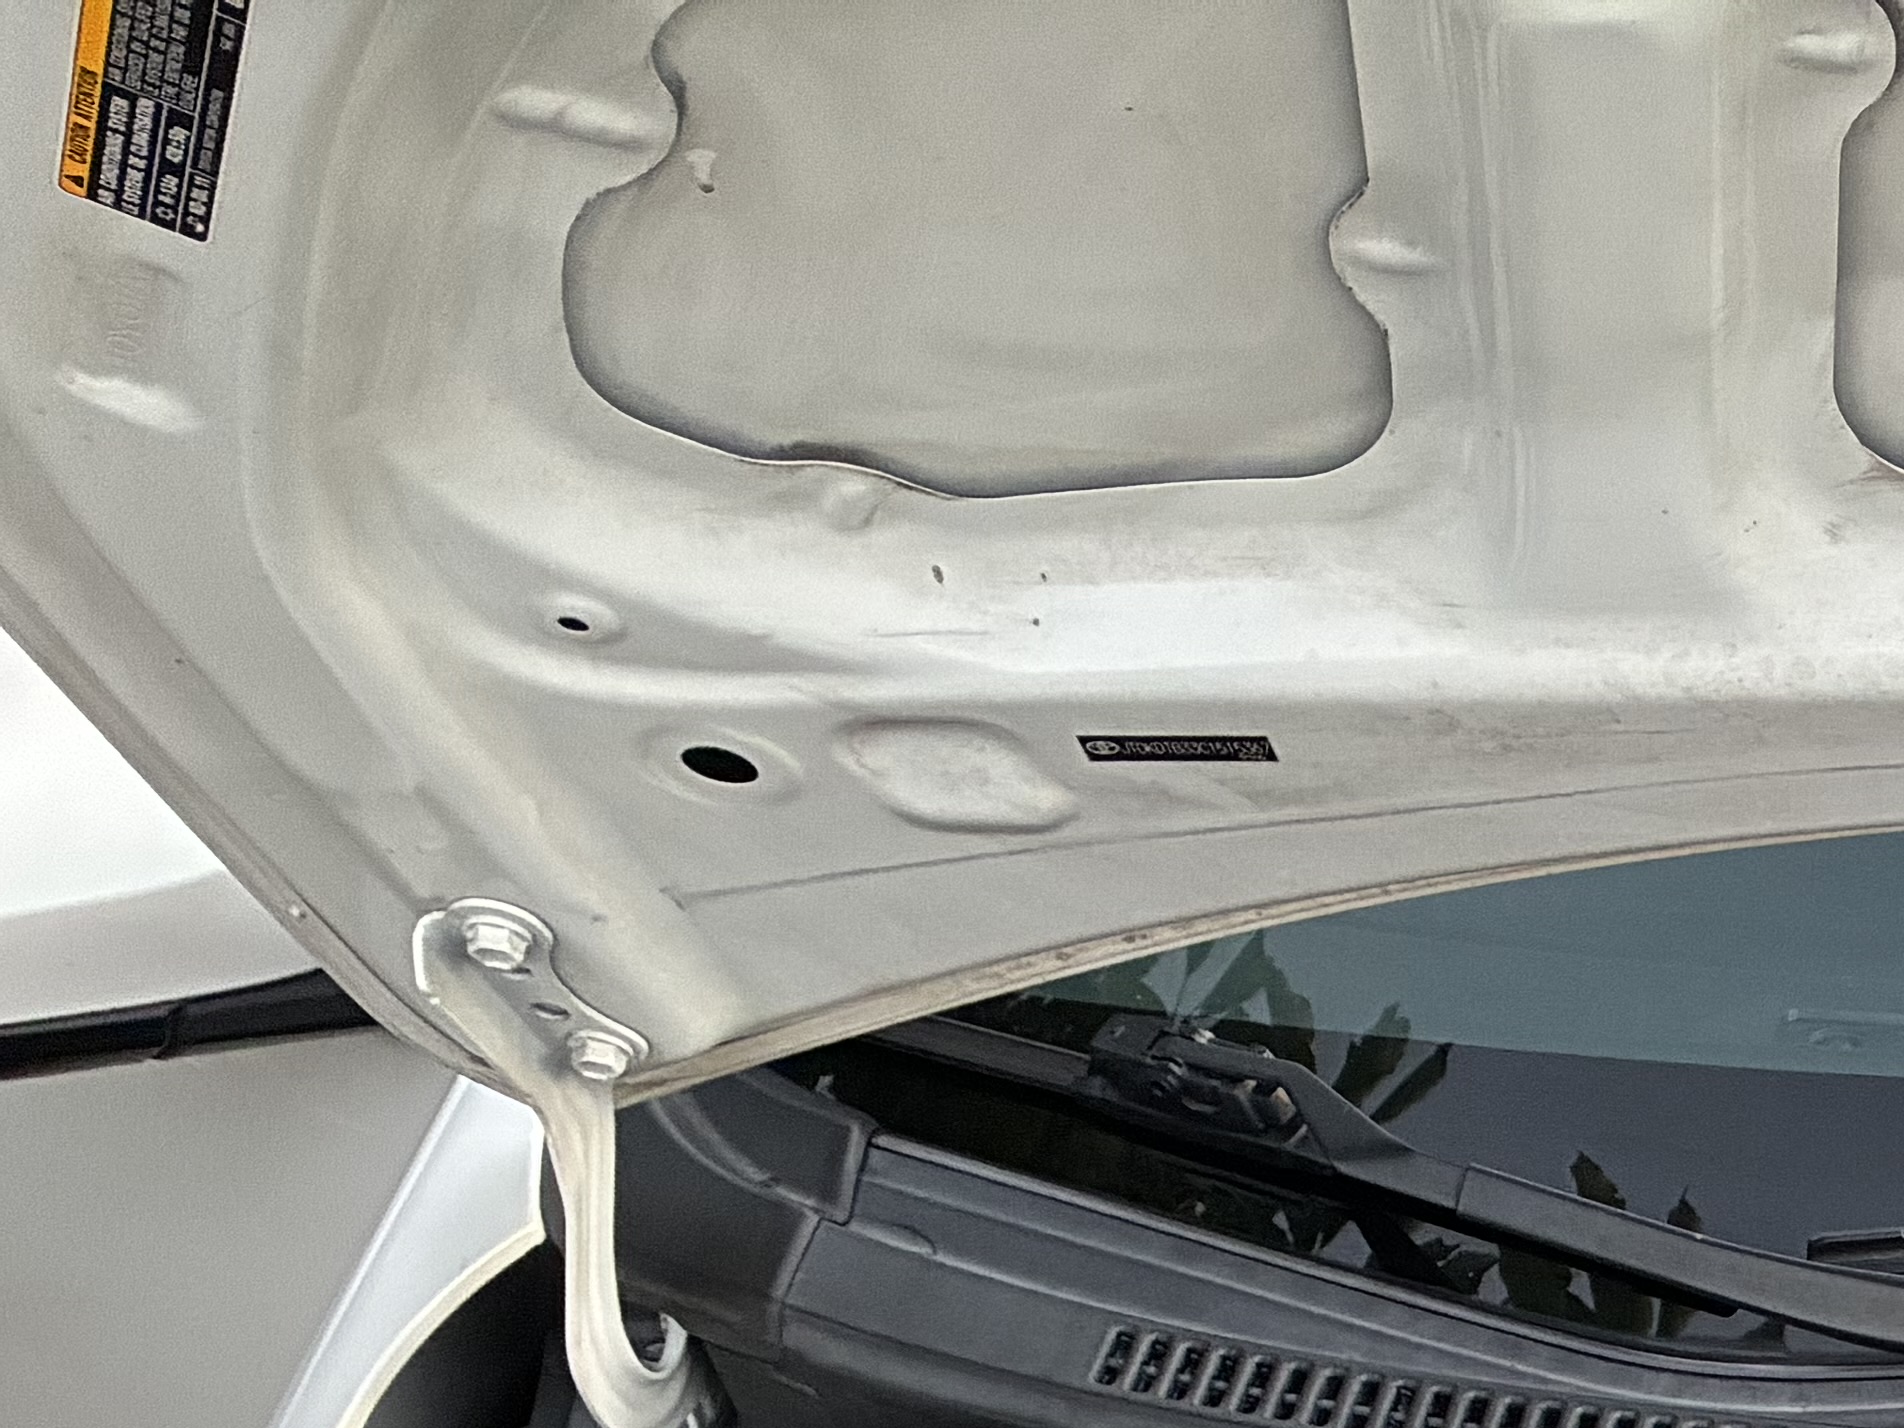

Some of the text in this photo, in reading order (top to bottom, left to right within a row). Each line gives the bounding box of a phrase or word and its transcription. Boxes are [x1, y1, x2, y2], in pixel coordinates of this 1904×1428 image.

[67, 65, 99, 165] CAUTION ATTENTION
[107, 95, 131, 132] SYSTEM
